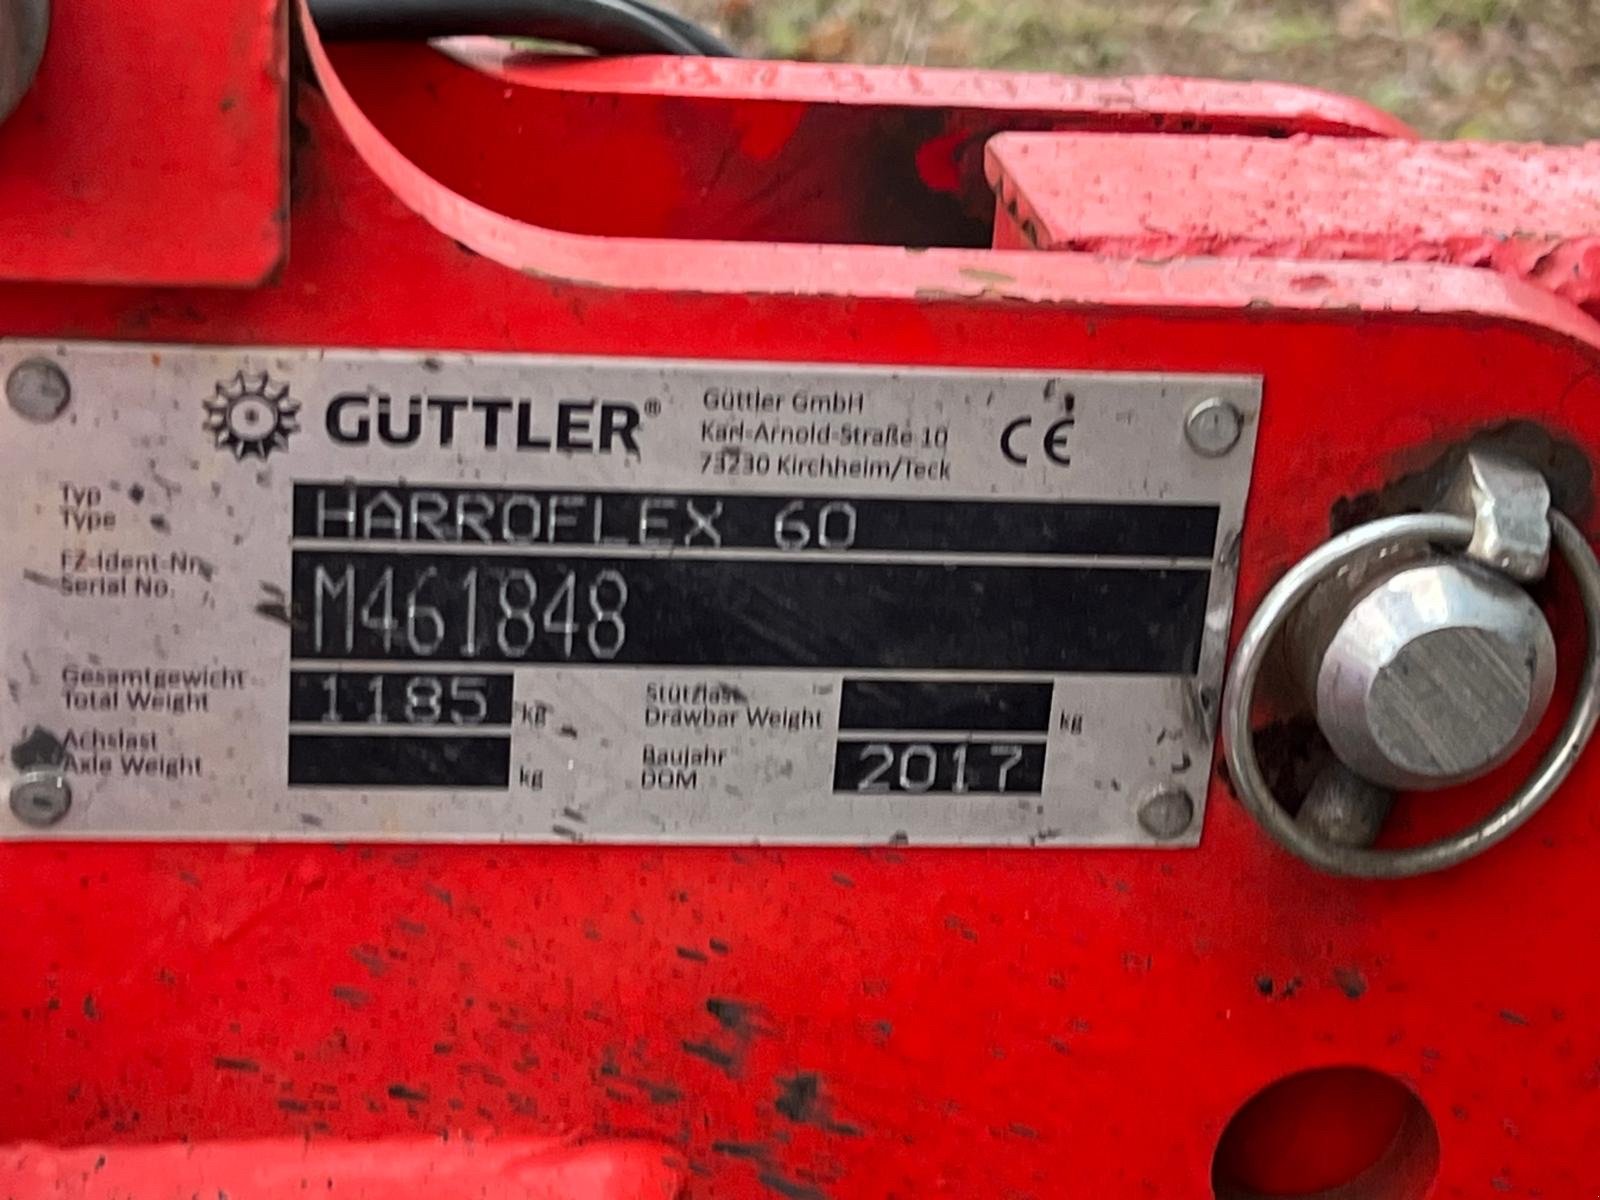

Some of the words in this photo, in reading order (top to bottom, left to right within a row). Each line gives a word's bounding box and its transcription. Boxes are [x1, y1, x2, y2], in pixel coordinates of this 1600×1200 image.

[702, 387, 785, 413] Güttler
[792, 390, 864, 416] GmbH
[921, 424, 950, 449] 10
[1000, 414, 1075, 466] CE
[60, 484, 102, 507] Typ
[60, 505, 116, 532] Type
[317, 489, 724, 547] HARROFLEX
[773, 501, 857, 550] 60
[60, 575, 127, 597] Serial
[313, 563, 629, 659] M461848
[62, 665, 246, 691] Gesamtgewicht
[62, 689, 119, 712] Total
[126, 689, 208, 714] Weight
[320, 676, 489, 724] 1185
[520, 702, 546, 729] kg
[645, 705, 738, 728] Drawbar
[746, 706, 823, 733] Weight
[1059, 711, 1083, 735] kg
[63, 728, 158, 751] Achslast
[62, 753, 113, 777] Axle
[120, 754, 203, 780] Weight
[641, 744, 728, 770] Baujahr
[857, 743, 1024, 793] 2017
[519, 767, 543, 791] kg
[641, 767, 698, 791] DOM
